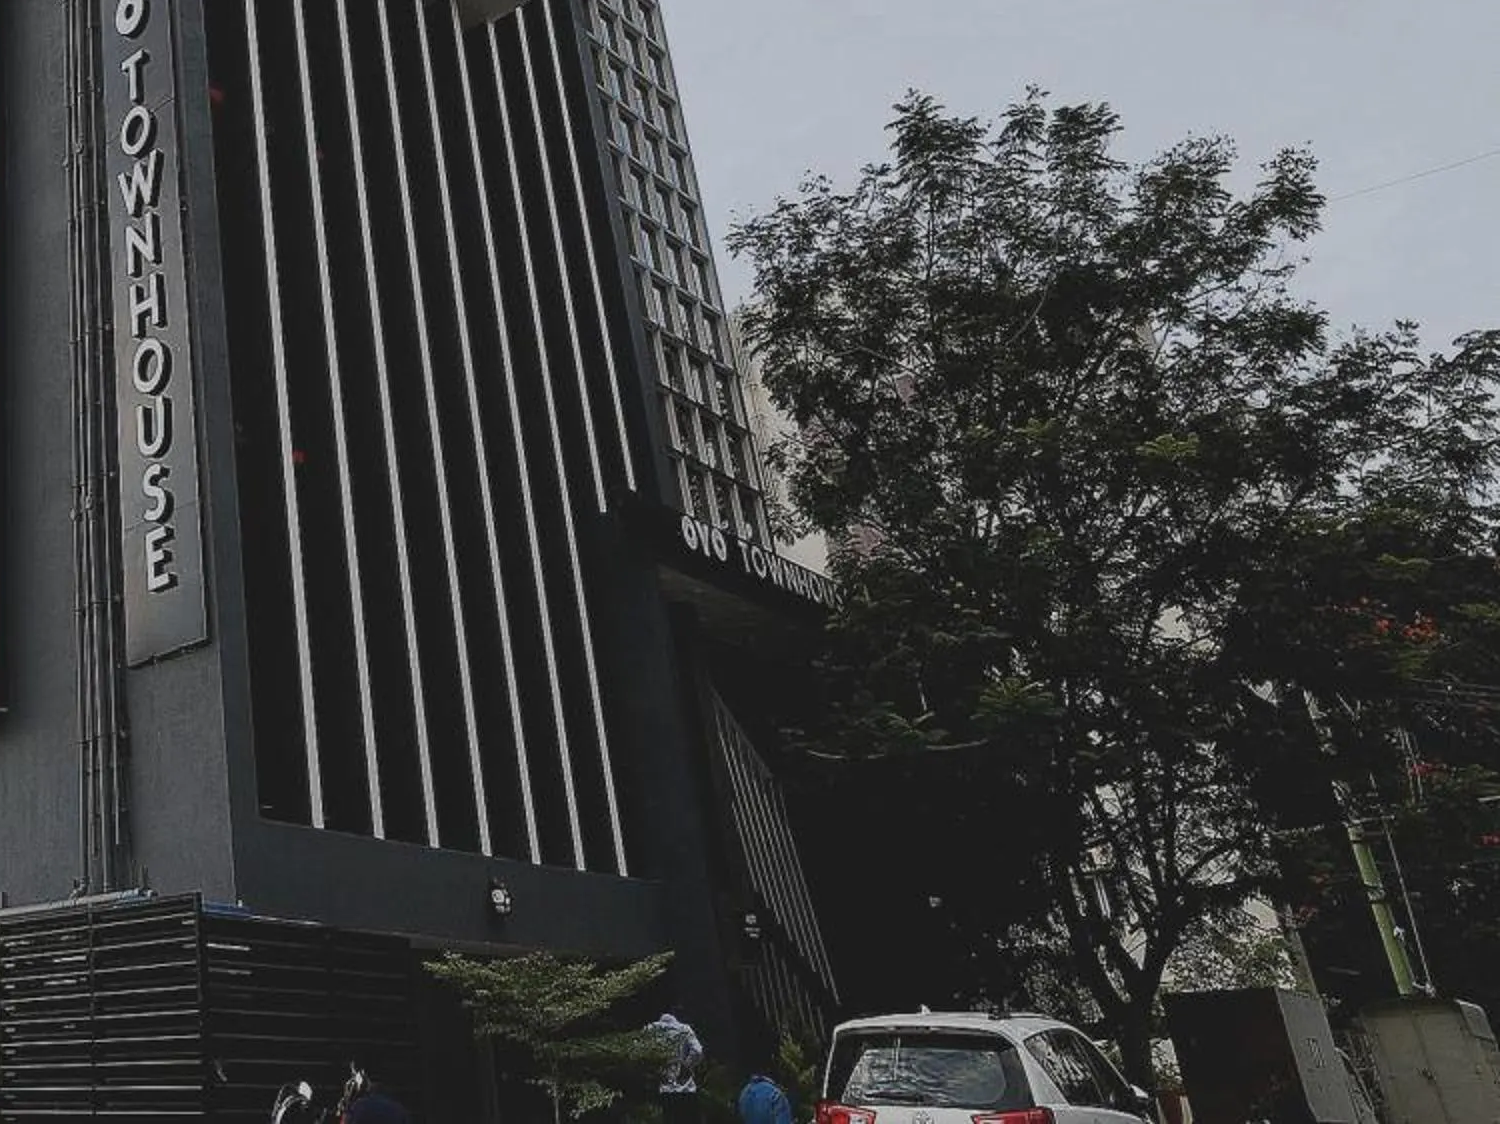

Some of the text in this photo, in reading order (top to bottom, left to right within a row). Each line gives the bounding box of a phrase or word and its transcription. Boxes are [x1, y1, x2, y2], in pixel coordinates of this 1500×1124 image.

[117, 48, 175, 593] TOWNHOUSE
[681, 515, 846, 612] OYO TOWNHOU
